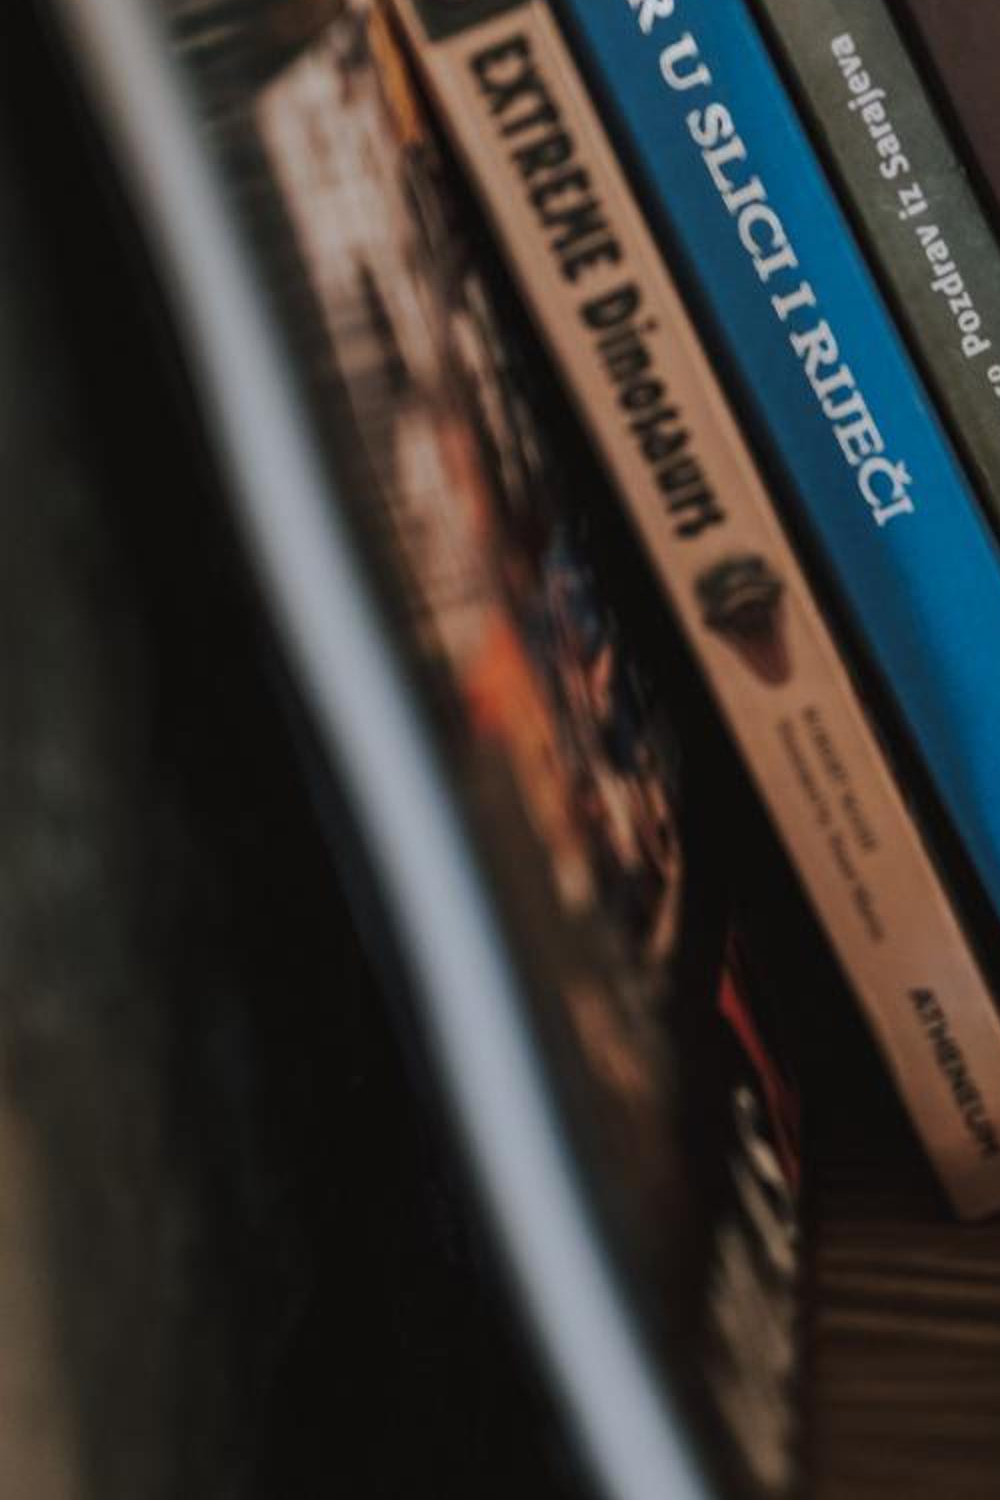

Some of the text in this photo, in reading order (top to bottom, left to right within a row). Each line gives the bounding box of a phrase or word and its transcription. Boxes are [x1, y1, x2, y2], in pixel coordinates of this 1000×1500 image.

[659, 33, 710, 92] U
[831, 34, 909, 179] Sarajeva
[687, 102, 798, 283] SLICI
[898, 185, 929, 219] iz
[471, 35, 724, 539] EXTREME Dinosaurs
[771, 281, 816, 321] I
[915, 223, 991, 358] Pozdrav
[789, 319, 915, 526] RIJEČI
